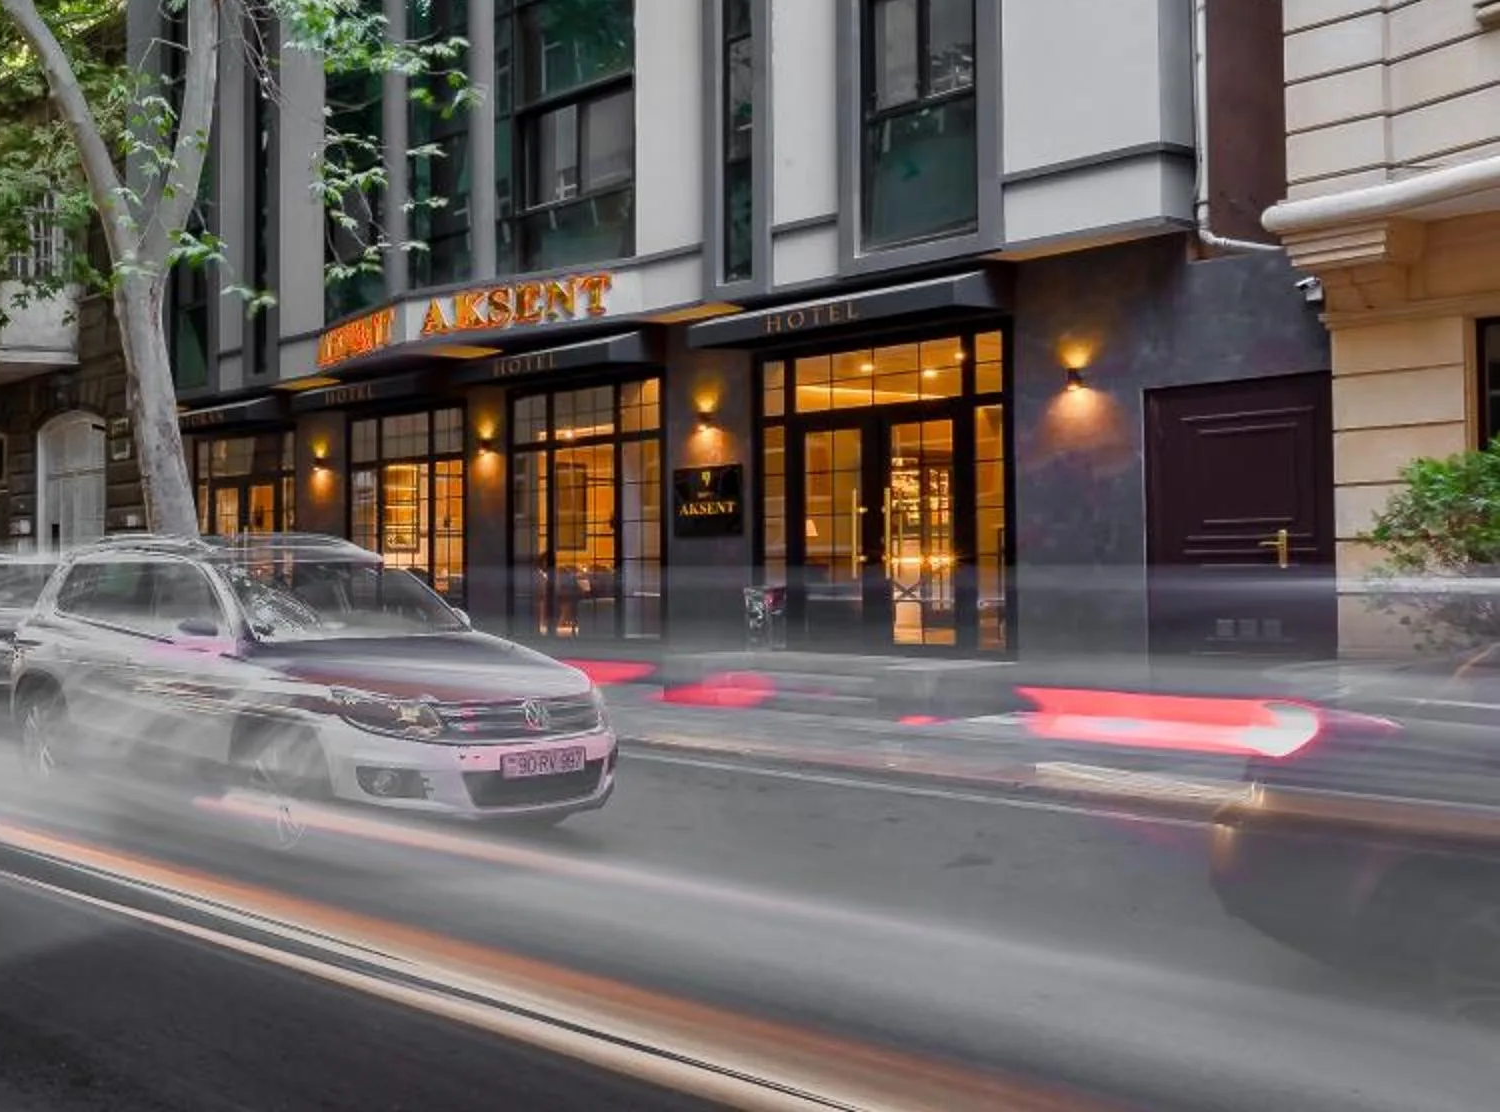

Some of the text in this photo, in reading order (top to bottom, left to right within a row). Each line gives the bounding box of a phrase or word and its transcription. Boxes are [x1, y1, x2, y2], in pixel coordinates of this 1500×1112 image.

[419, 271, 613, 335] AKSENT
[762, 301, 861, 334] HOTEL
[492, 352, 557, 378] HOTEL
[324, 383, 374, 405] HOTEL
[679, 500, 737, 517] AKSENT
